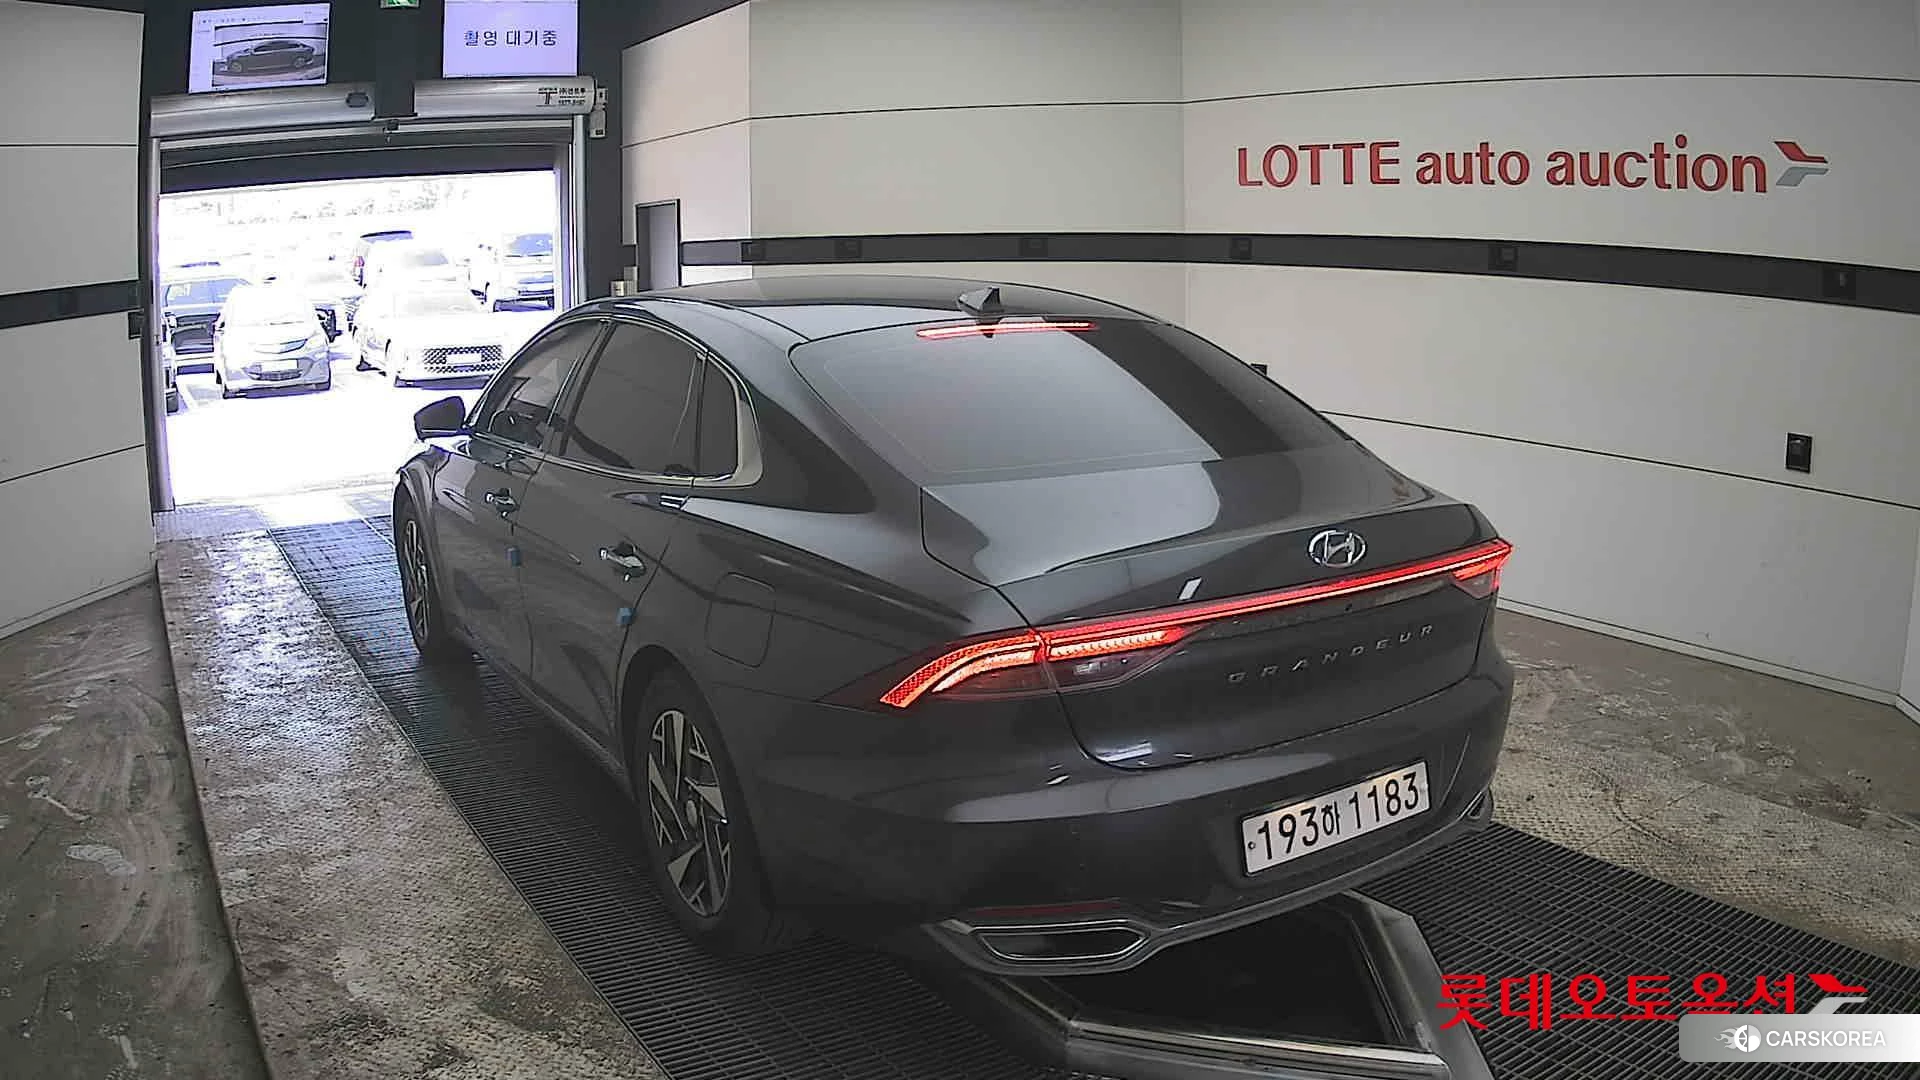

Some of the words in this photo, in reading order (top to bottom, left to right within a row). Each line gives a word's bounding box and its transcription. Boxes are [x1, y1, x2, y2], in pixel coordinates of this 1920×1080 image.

[505, 29, 558, 47] 대기중
[1237, 141, 1401, 188] LOTTE
[1415, 141, 1531, 186] auto
[1545, 134, 1768, 194] auction
[1228, 624, 1433, 683] GRANDEUR
[1256, 800, 1341, 861] 193하
[1348, 771, 1420, 830] 1183
